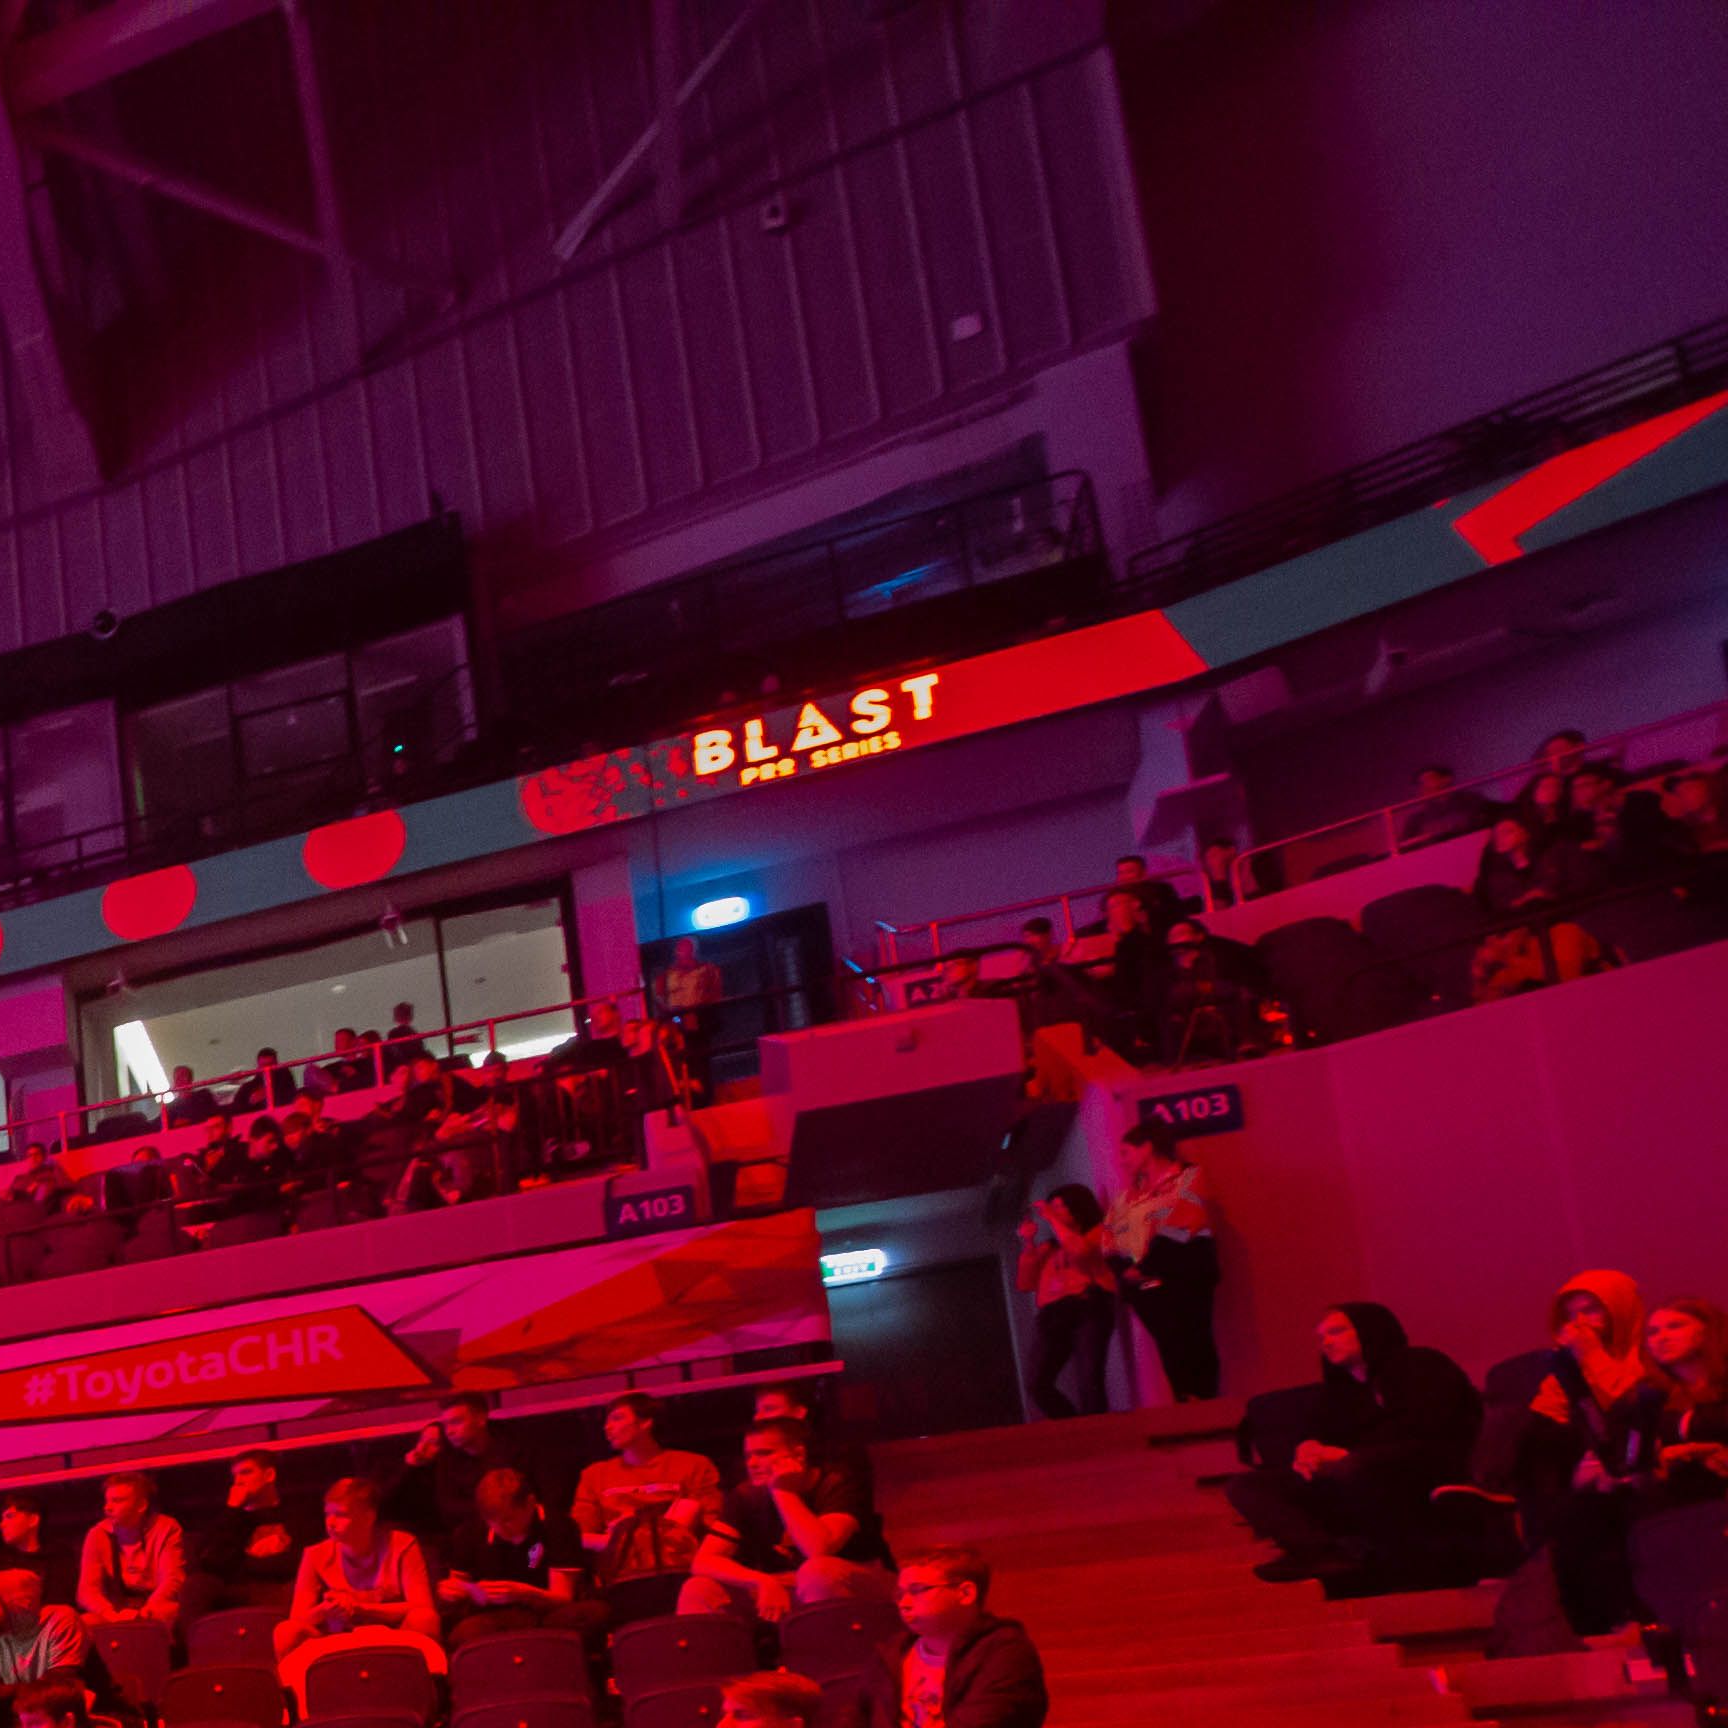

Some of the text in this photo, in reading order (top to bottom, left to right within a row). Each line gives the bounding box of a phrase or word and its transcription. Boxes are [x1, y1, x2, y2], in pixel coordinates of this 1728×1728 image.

[693, 673, 939, 776] BLAST
[809, 731, 902, 768] SERIES
[1152, 1093, 1230, 1124] A103
[619, 1194, 686, 1224] A103
[23, 1323, 343, 1406] #ToyotaCHR
